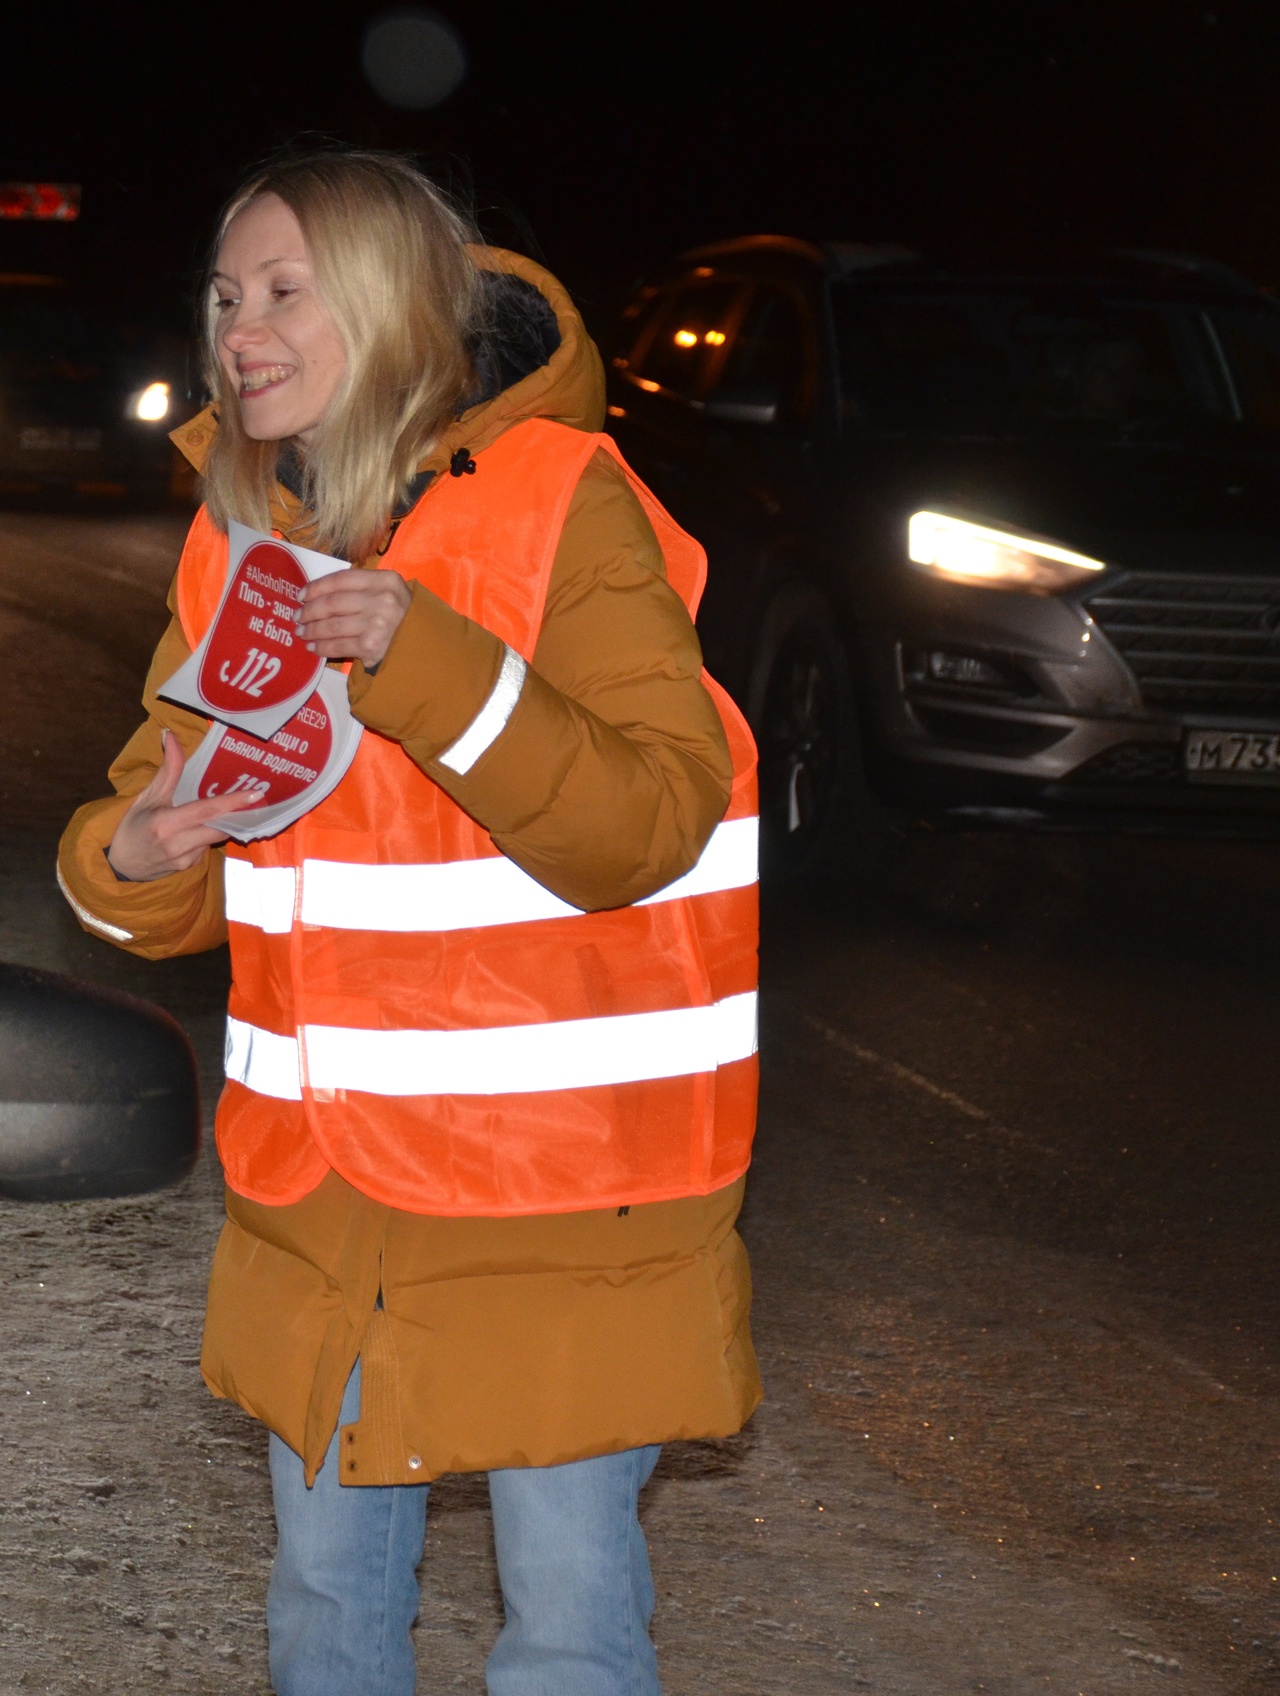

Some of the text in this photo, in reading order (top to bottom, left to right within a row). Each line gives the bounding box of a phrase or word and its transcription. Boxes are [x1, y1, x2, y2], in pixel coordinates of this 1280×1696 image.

[238, 581, 265, 609] Пить
[272, 601, 294, 621] зна
[246, 564, 301, 601] #AlcoholFRE
[249, 616, 293, 647] не быть
[229, 647, 282, 698] 112
[297, 707, 327, 730] REE29
[221, 735, 318, 783] пьяном водителе
[299, 741, 309, 754] о
